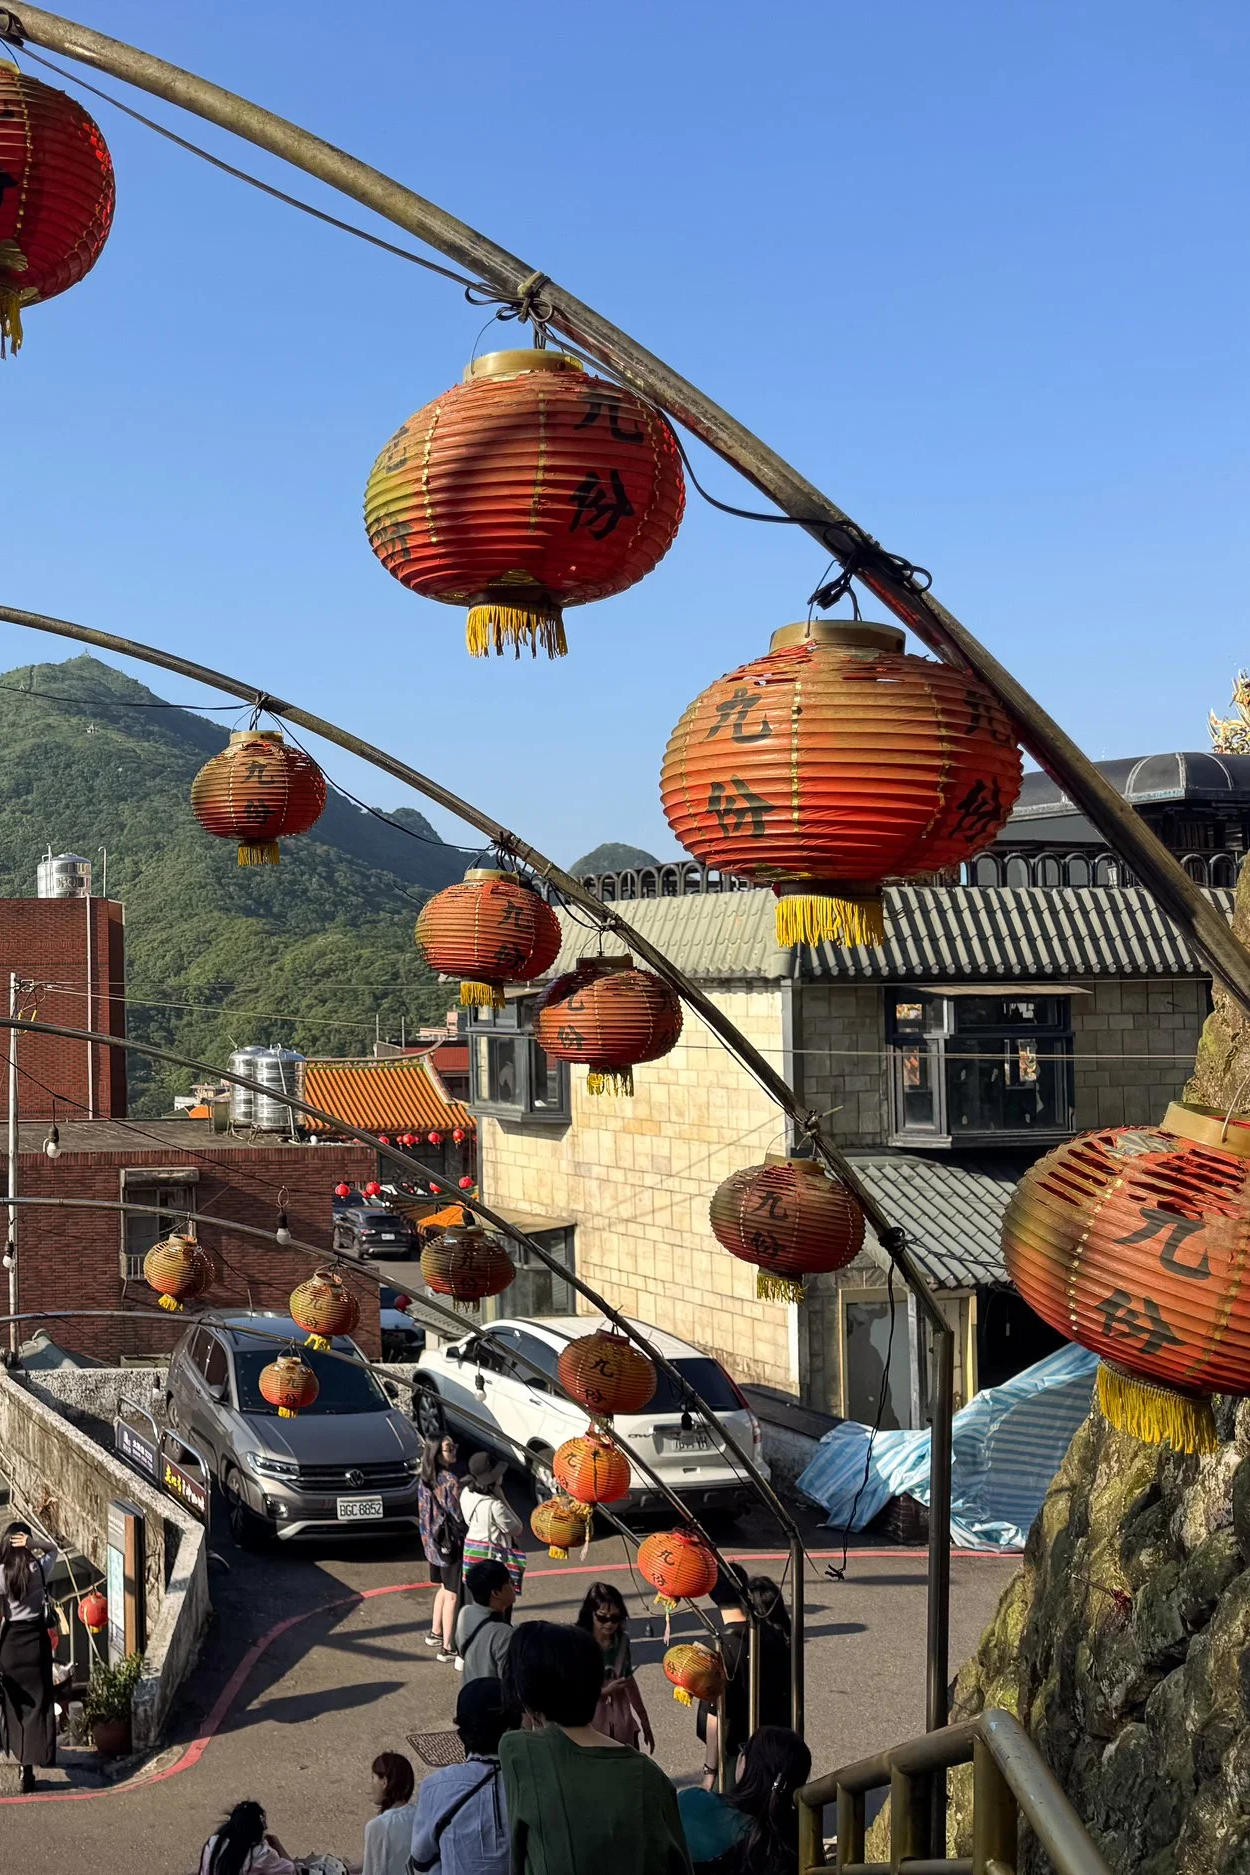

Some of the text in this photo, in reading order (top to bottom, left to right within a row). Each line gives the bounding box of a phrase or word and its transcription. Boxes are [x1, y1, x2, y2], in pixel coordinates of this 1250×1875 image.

[569, 391, 644, 540] 九份
[241, 760, 276, 826] 九份
[705, 687, 776, 837] 九份
[751, 1192, 789, 1259] 九份
[1096, 1206, 1210, 1355] 九份
[651, 1549, 675, 1586] 九份
